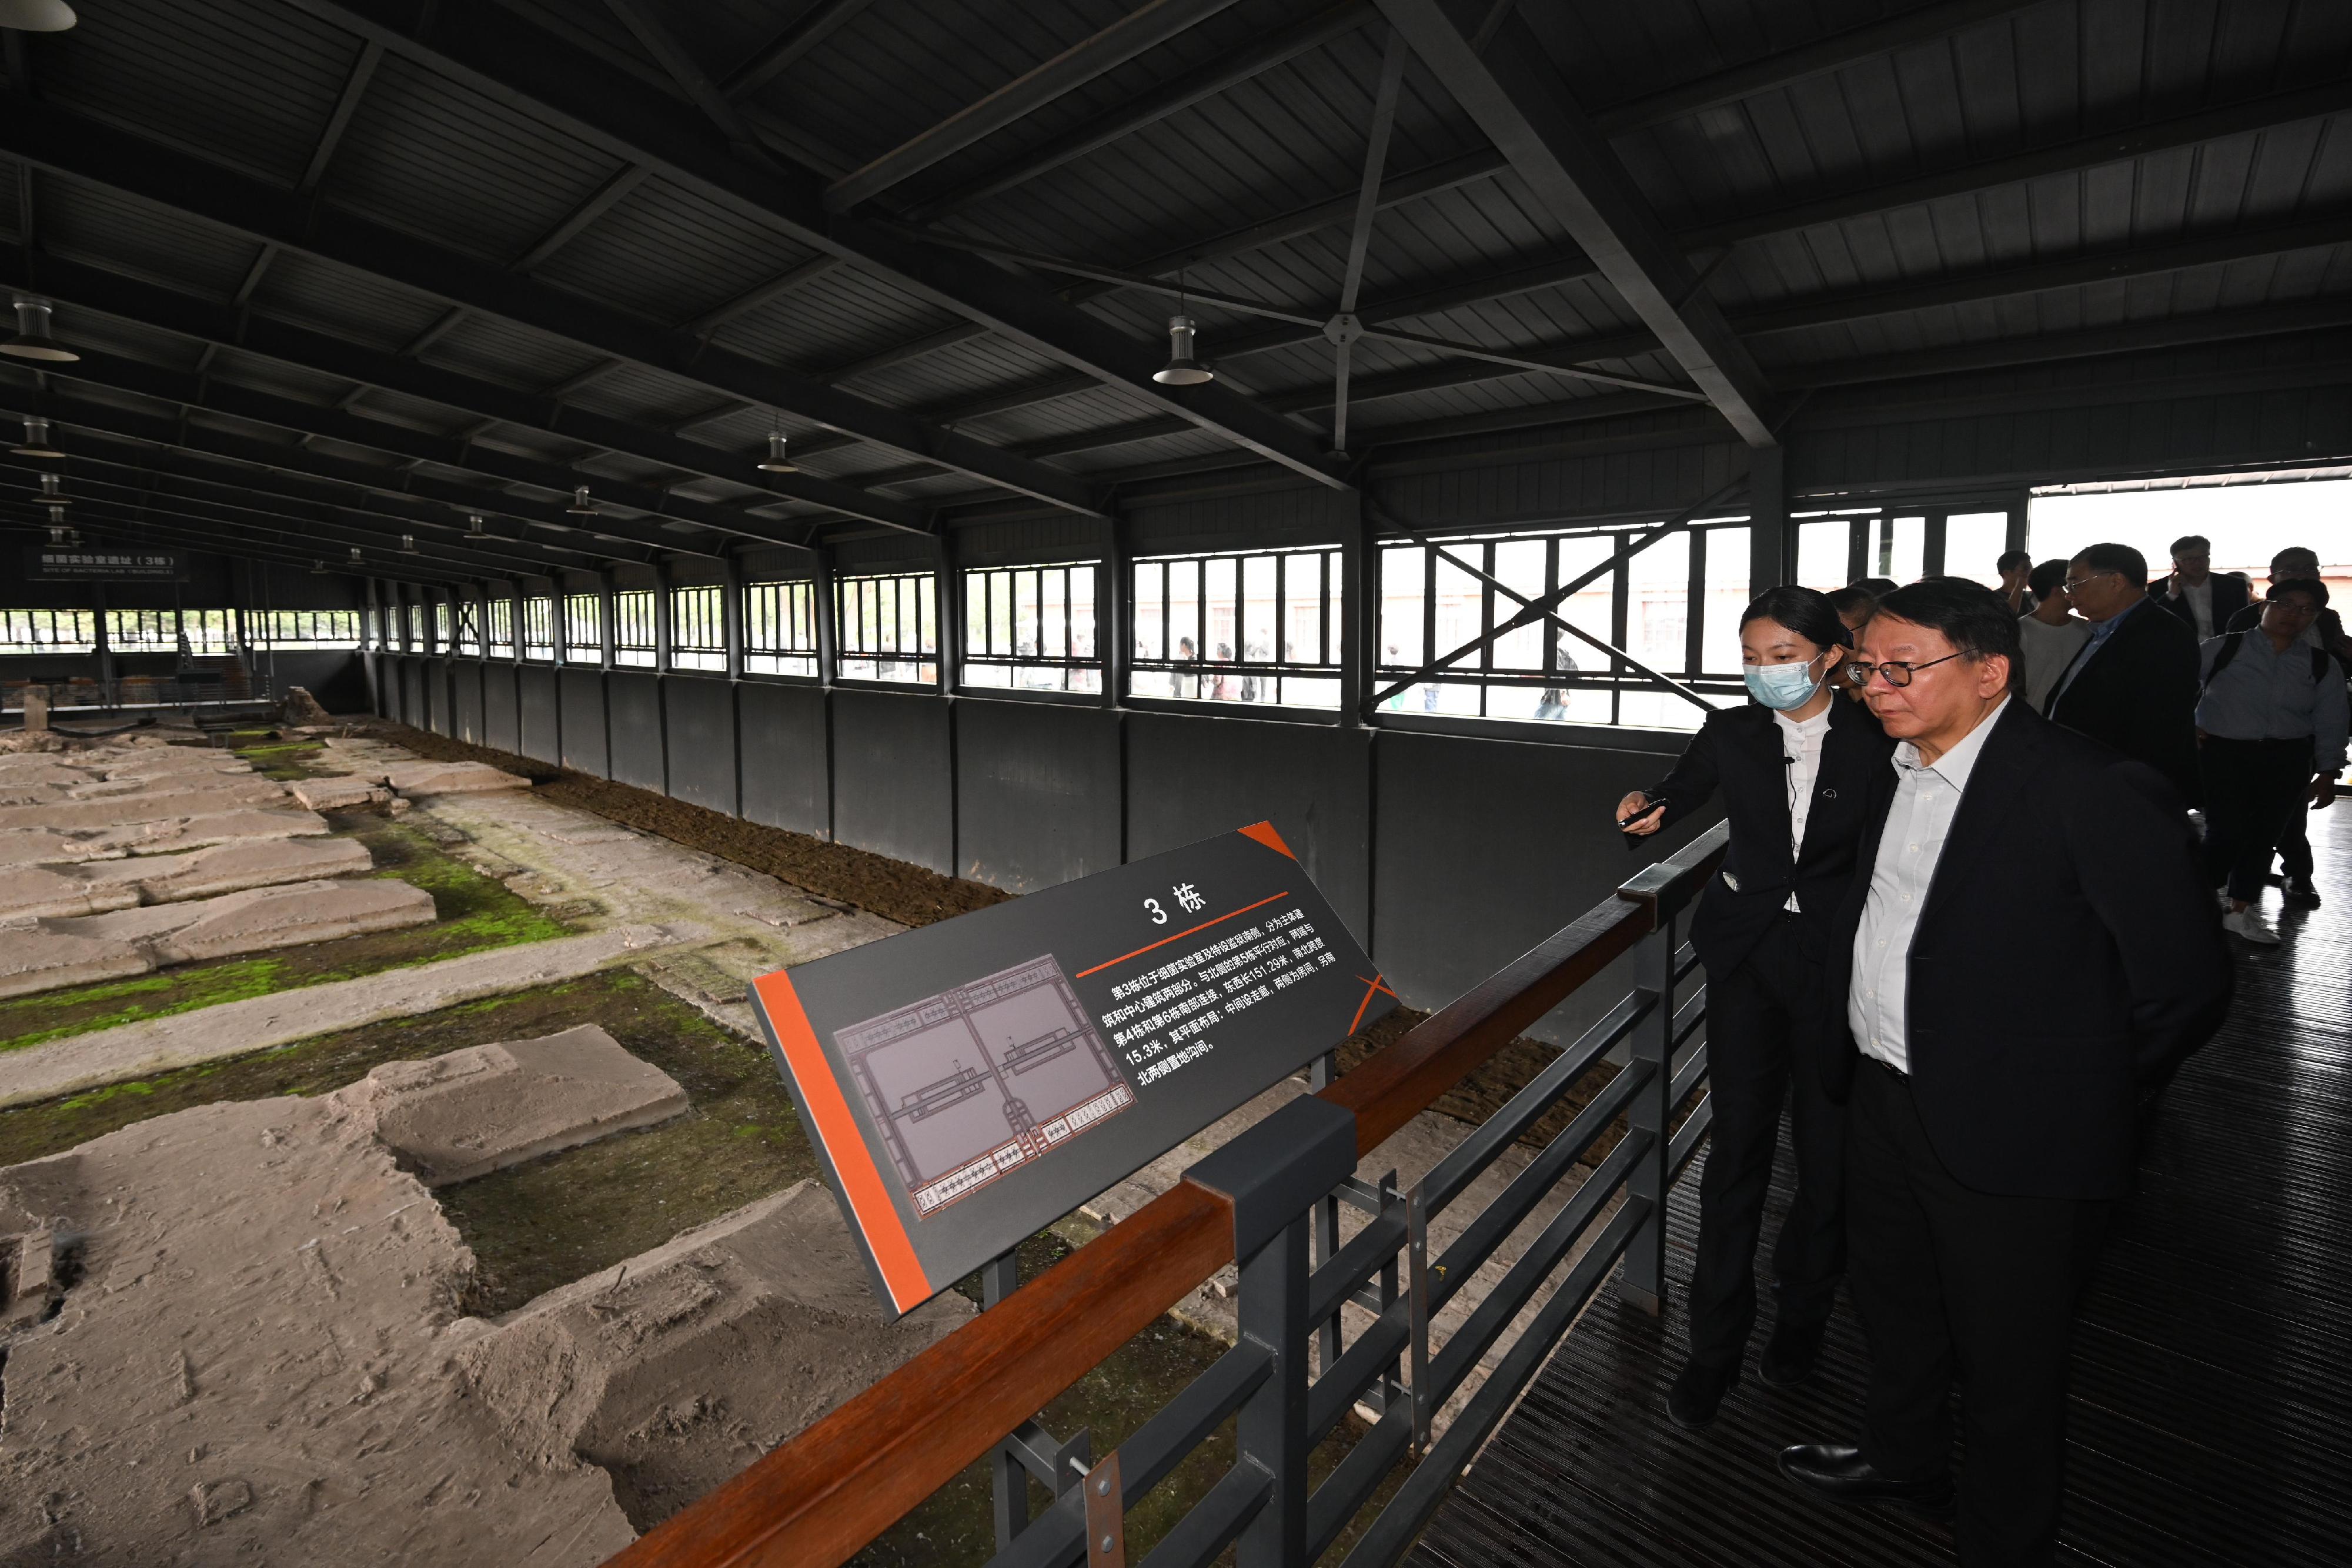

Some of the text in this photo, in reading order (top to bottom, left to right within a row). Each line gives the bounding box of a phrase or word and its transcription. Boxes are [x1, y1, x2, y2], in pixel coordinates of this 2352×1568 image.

[1144, 882, 1207, 925] 3 栋
[1102, 923, 1314, 1028] 筑和中心建筑两部分。与北侧的第5栋平行对应，两端与
[1111, 908, 1305, 1001] 第3栋位于细菌实验室及特设监狱南侧，分为主体建
[1113, 937, 1326, 1048] 第4栋和第6栋南部连接，东西长151.29米，南北跨度
[1125, 951, 1336, 1066] 15.3米，其平面布局：中间设走廊，两侧为房间，另南
[1137, 1040, 1214, 1086] 北两侧置地沟间。
